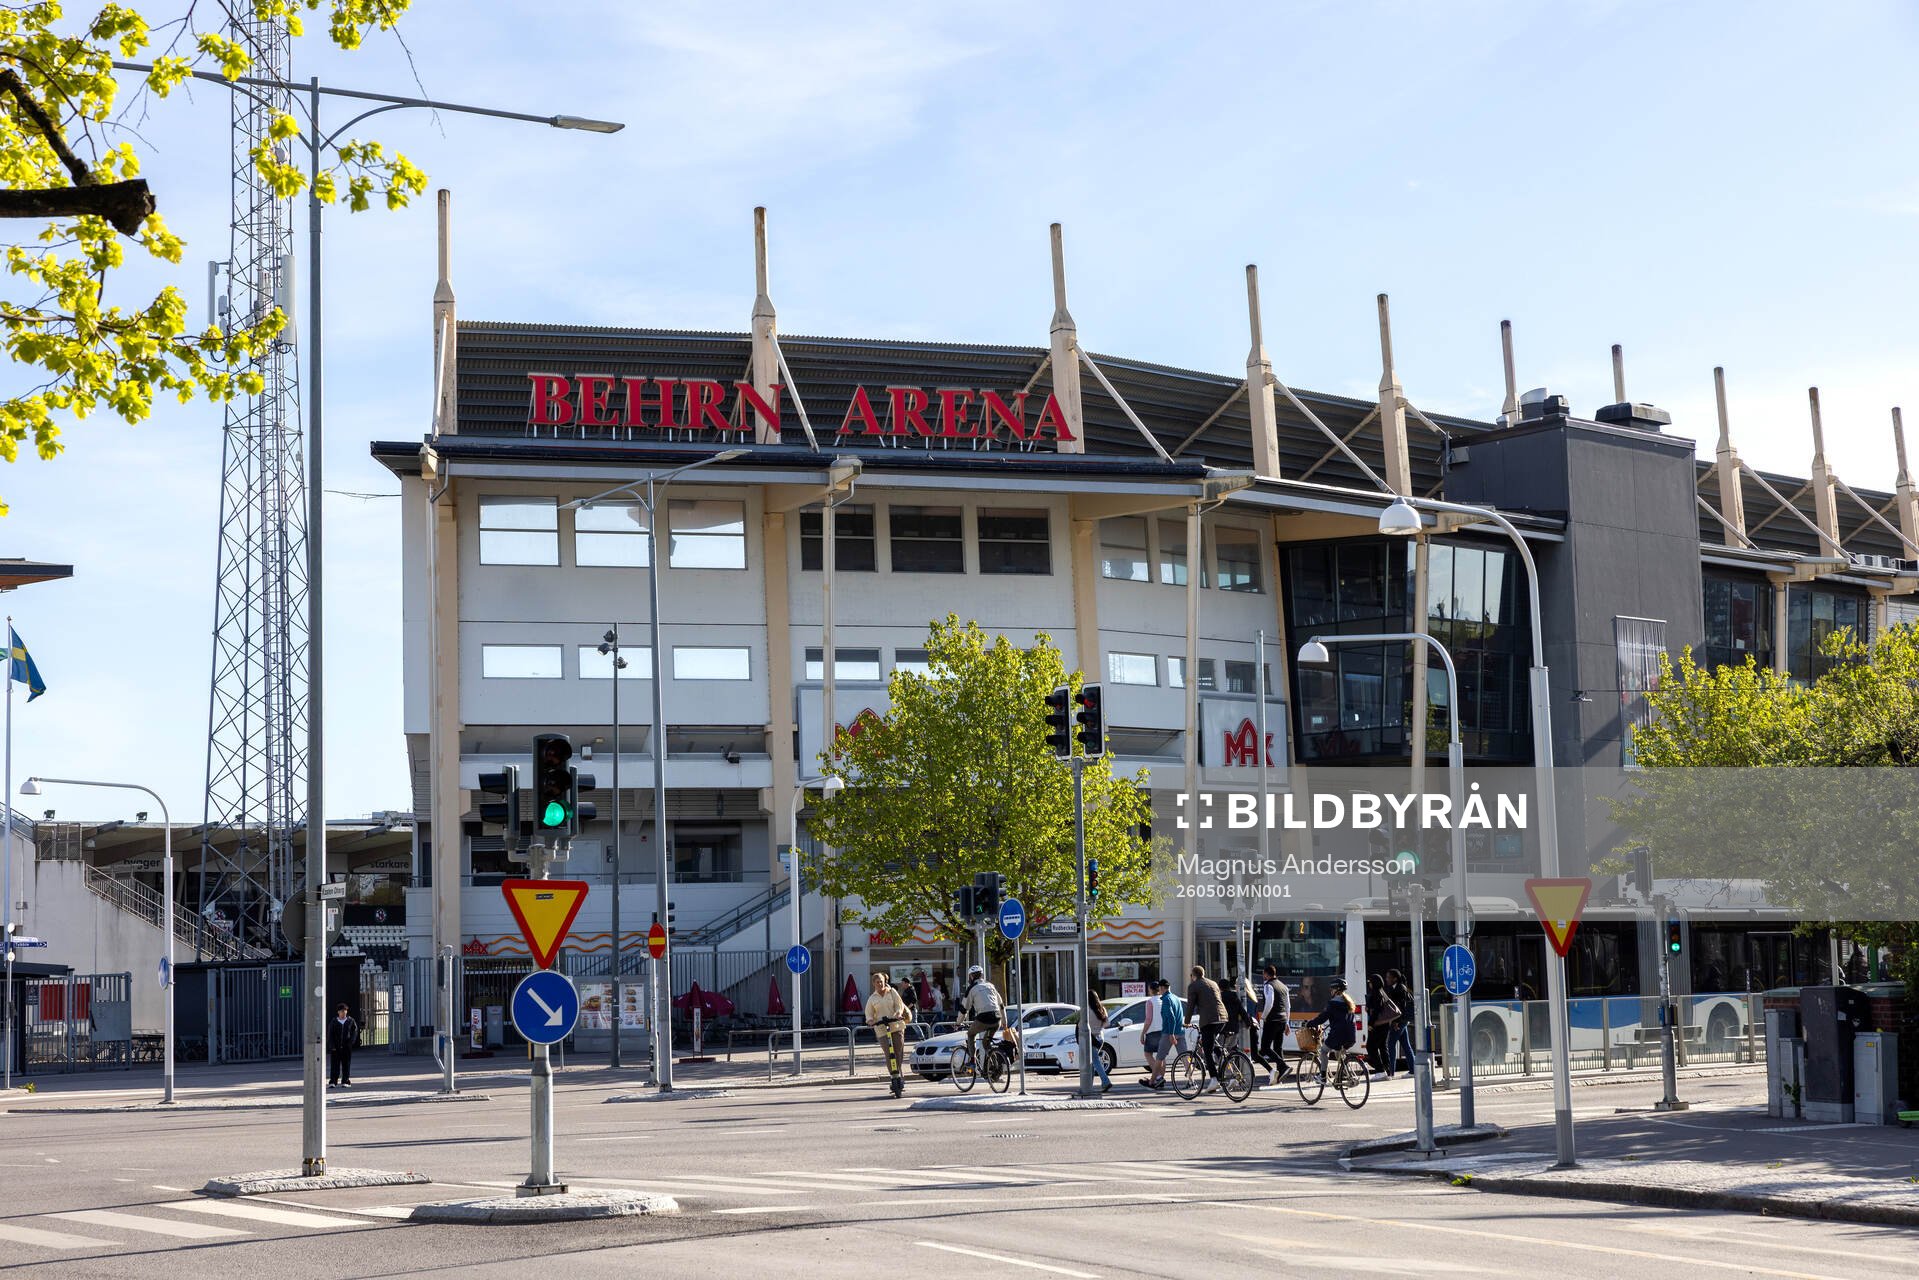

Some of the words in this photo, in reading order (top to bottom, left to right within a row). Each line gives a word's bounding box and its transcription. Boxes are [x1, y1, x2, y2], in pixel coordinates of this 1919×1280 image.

[528, 373, 785, 433] BEHRN
[839, 385, 1077, 442] ARENA
[1299, 921, 1305, 934] 2
[463, 935, 489, 956] MAX
